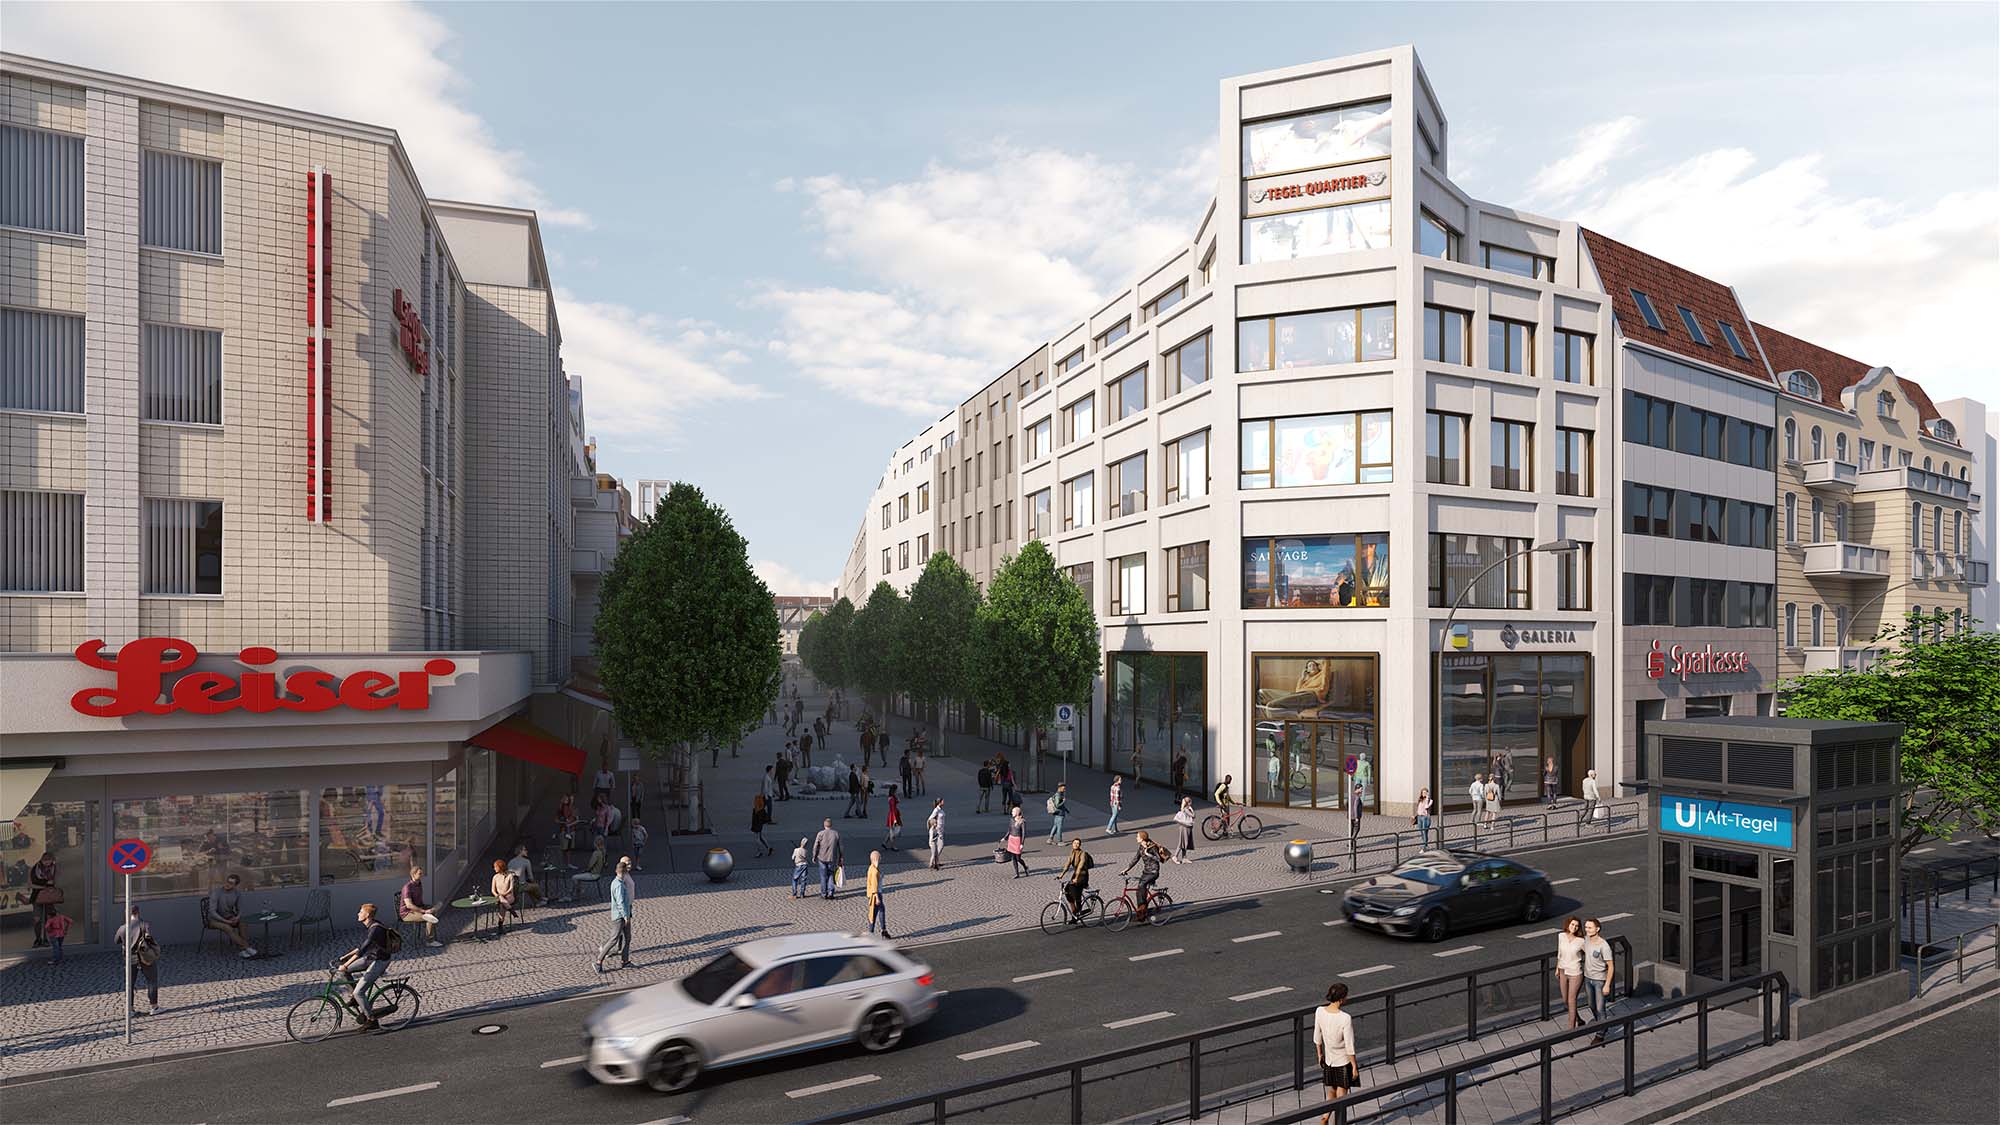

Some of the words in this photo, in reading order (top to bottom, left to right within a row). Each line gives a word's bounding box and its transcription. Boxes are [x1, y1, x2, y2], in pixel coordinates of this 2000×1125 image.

[1267, 185, 1303, 201] TEGEL
[1305, 175, 1368, 196] QUARTIER
[1521, 631, 1577, 644] GALERIA
[70, 636, 456, 718] Leiser
[1670, 643, 1750, 681] Sparkasse
[1675, 801, 1696, 828] U
[1705, 810, 1778, 834] Alt-Tegel
